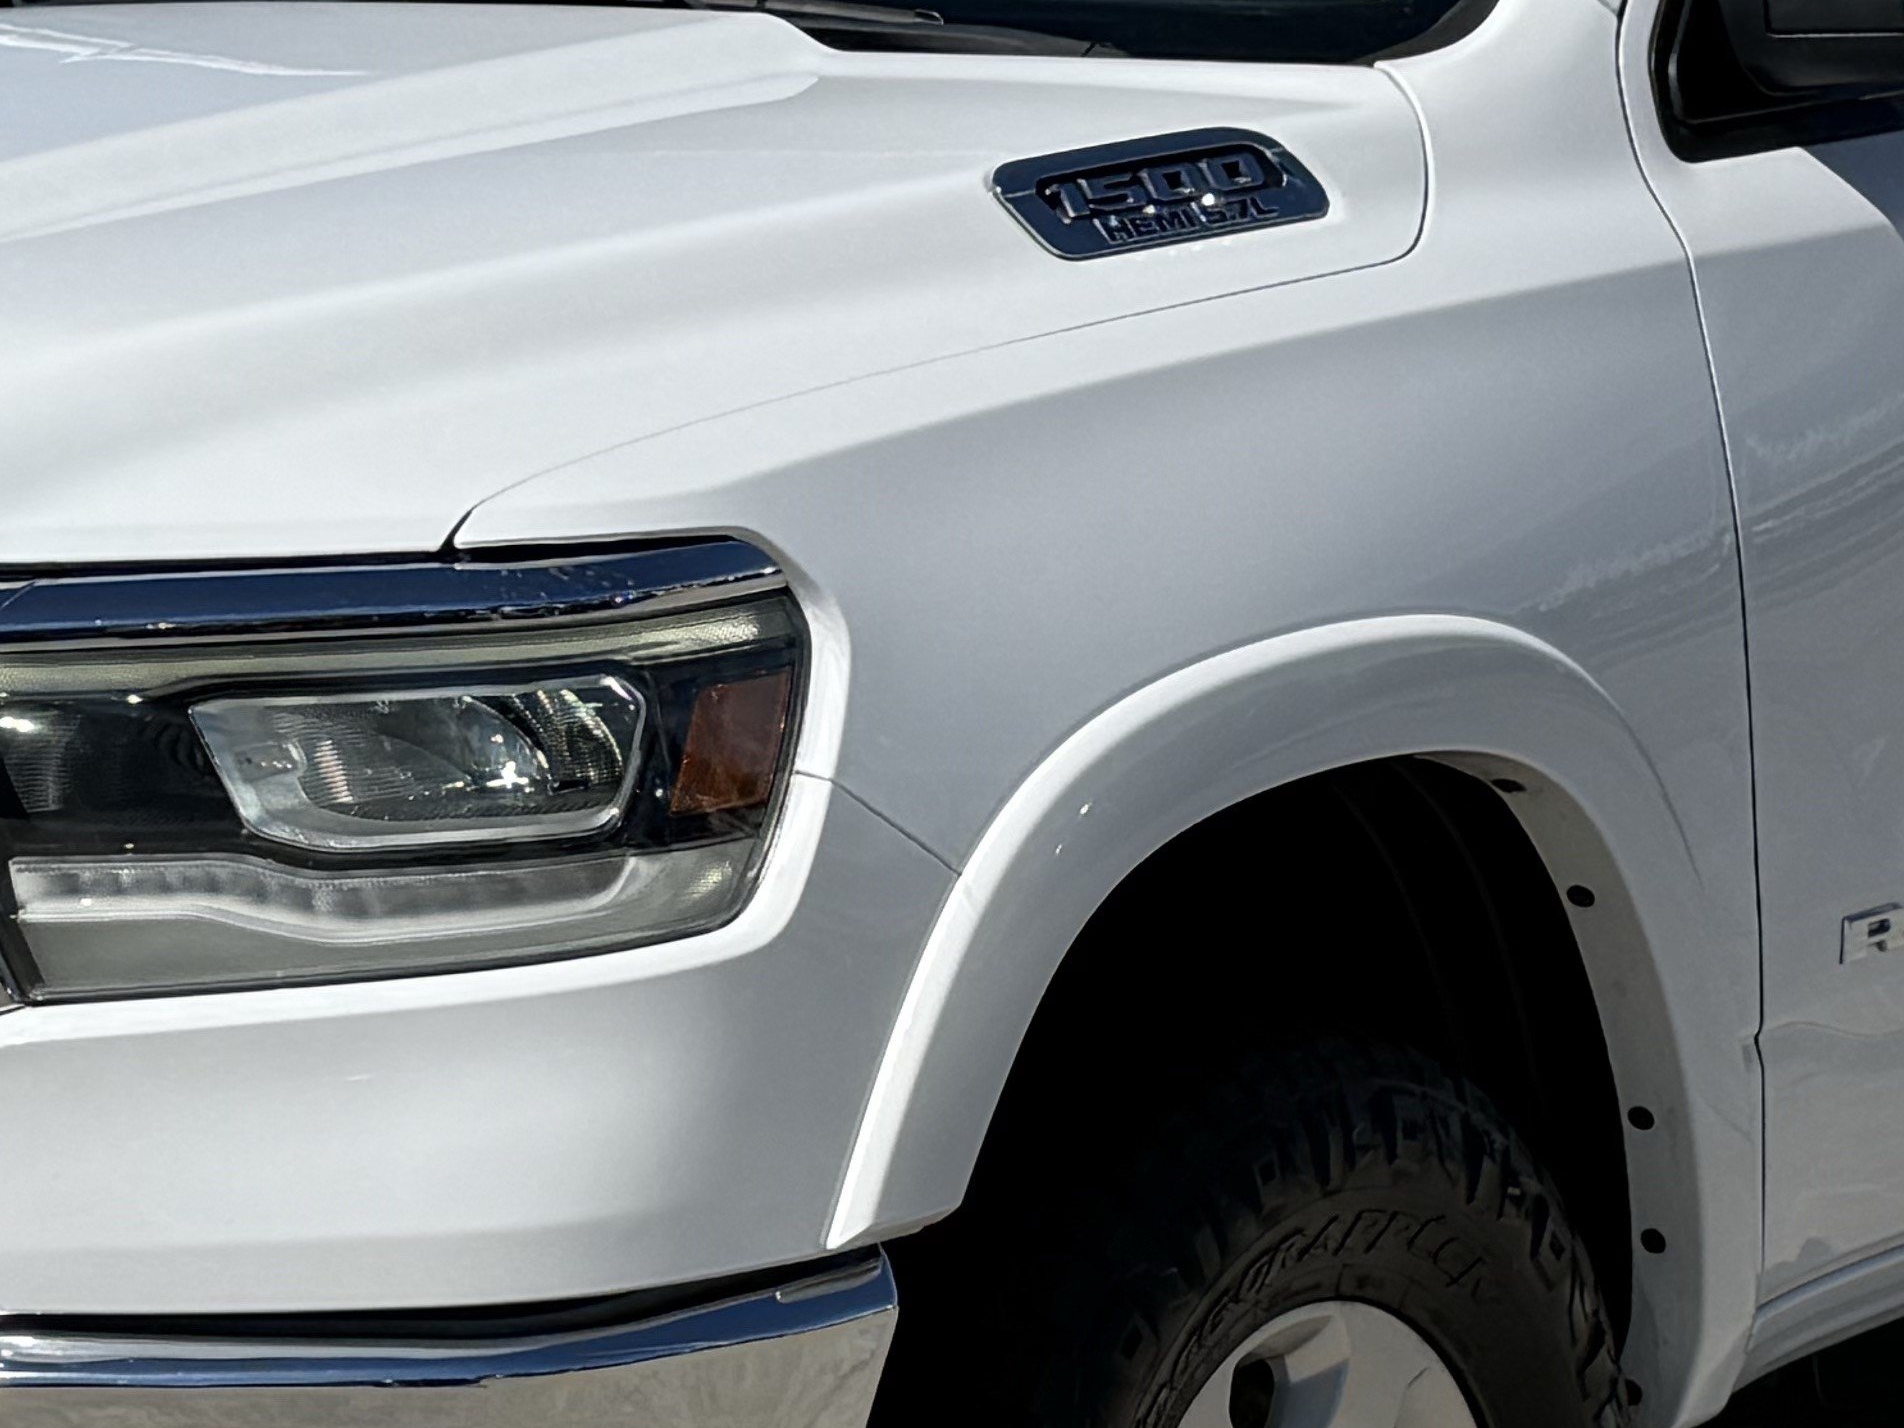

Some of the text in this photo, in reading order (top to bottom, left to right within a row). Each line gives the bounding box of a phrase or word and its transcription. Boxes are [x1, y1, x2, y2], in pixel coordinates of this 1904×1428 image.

[1045, 154, 1265, 223] 1500
[1092, 195, 1280, 244] HEMI 5.7L
